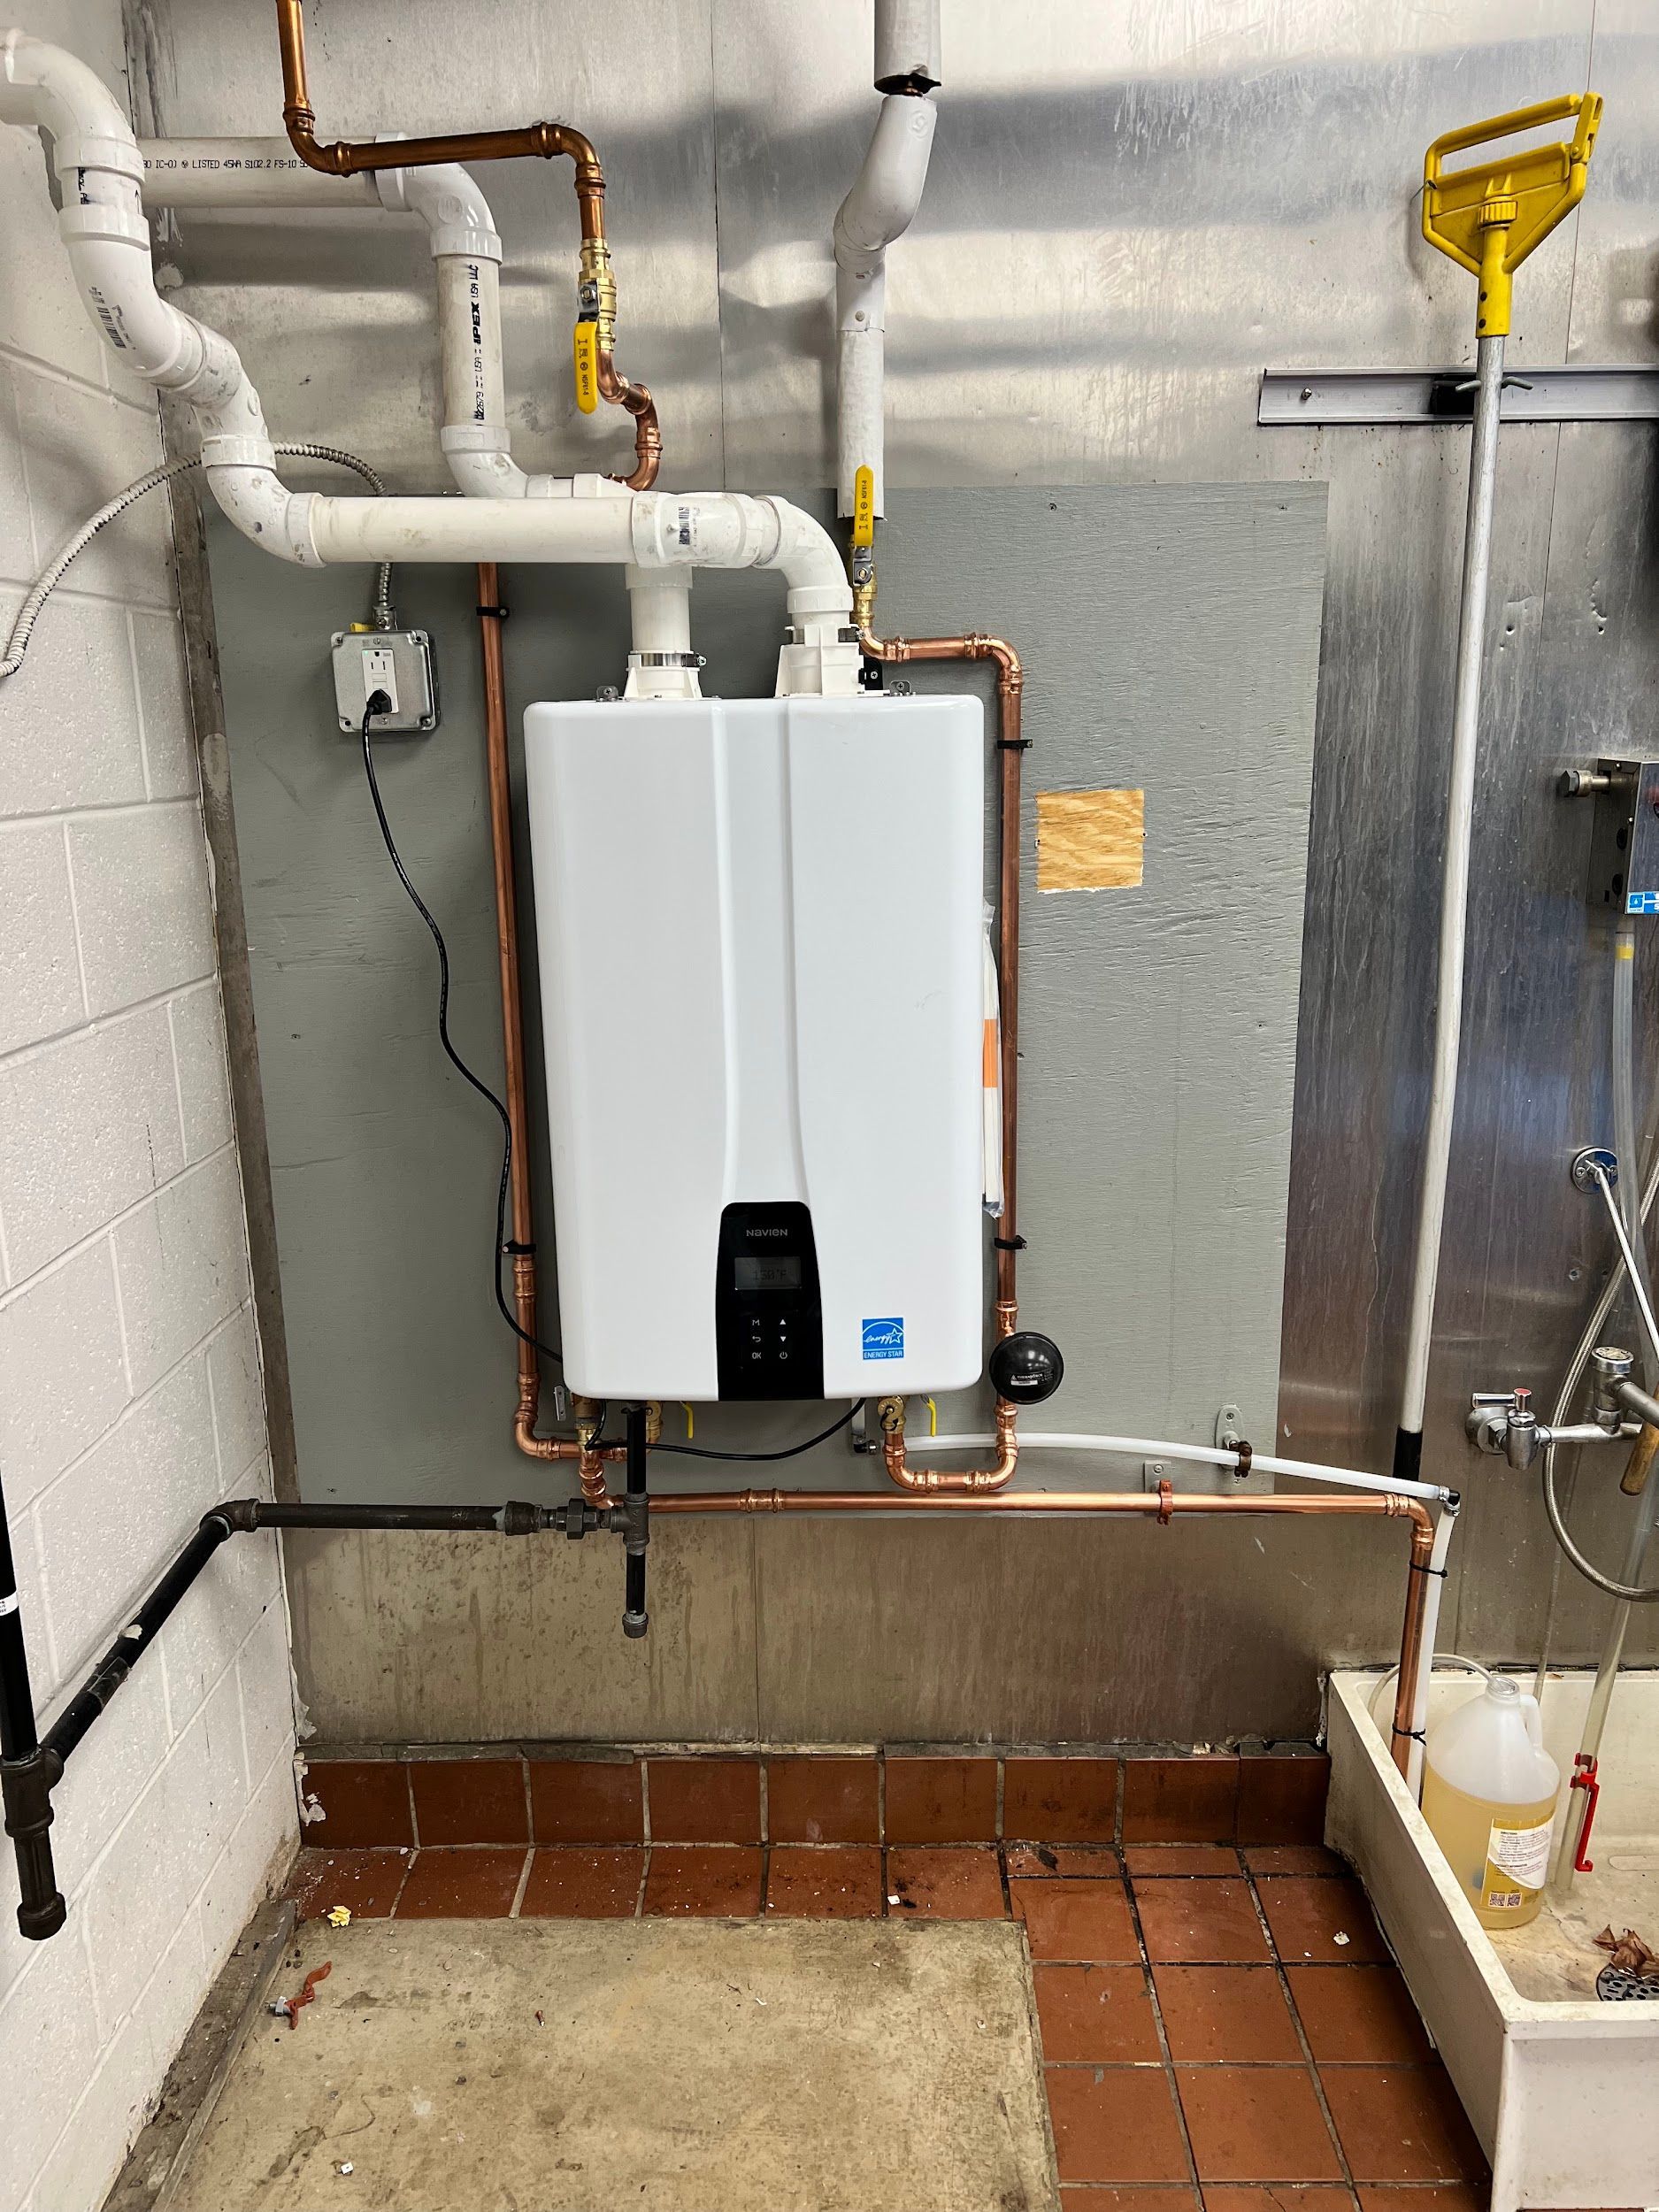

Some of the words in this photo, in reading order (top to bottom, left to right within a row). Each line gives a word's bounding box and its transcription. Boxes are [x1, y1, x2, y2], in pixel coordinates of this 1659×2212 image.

[192, 159, 220, 169] LISTED
[274, 159, 297, 169] FS-10
[468, 265, 479, 280] LLC
[470, 282, 479, 298] USA
[471, 302, 481, 344] IPEX
